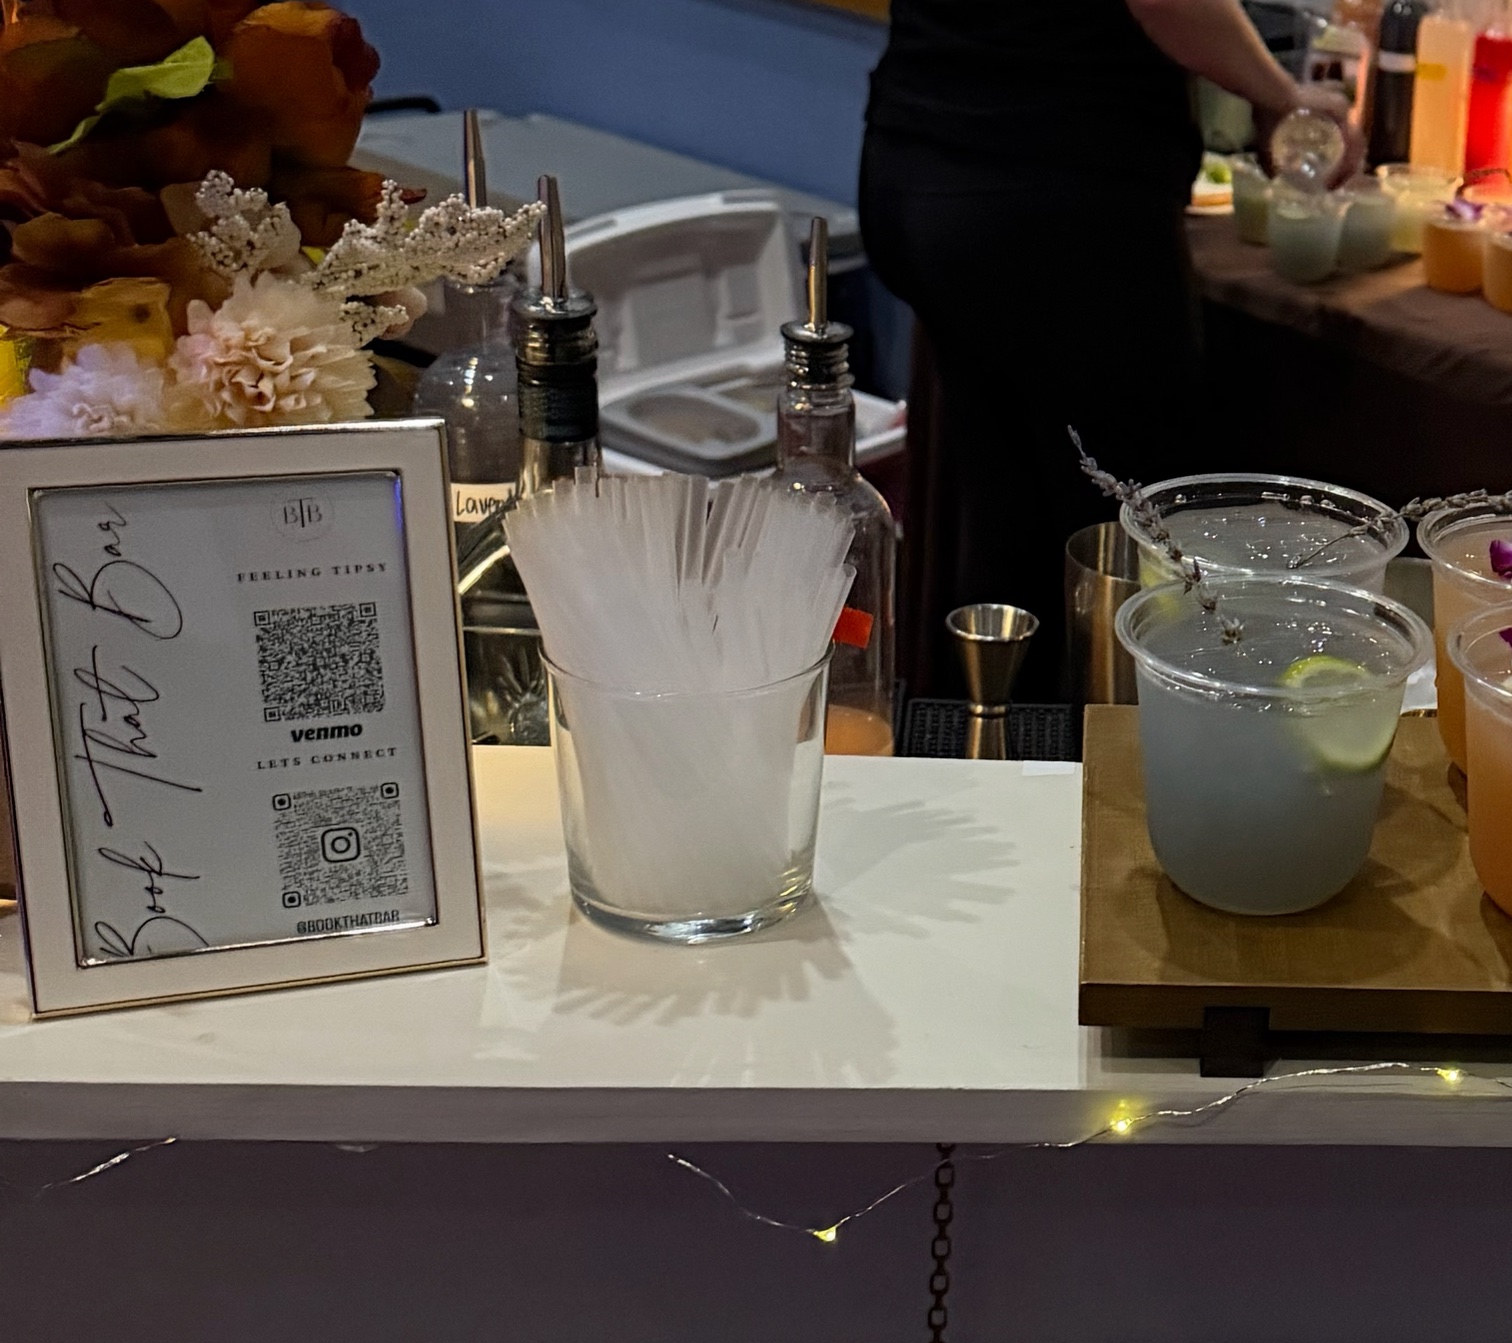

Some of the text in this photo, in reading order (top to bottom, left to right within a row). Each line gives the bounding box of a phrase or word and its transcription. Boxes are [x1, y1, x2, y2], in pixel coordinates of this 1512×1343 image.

[236, 562, 388, 584] FEELING TIPSY
[53, 502, 210, 957] Book That Bar
[290, 723, 364, 743] venmo
[257, 747, 398, 770] LETS CONNECT
[296, 909, 400, 934] @BOOKTHATBAR
